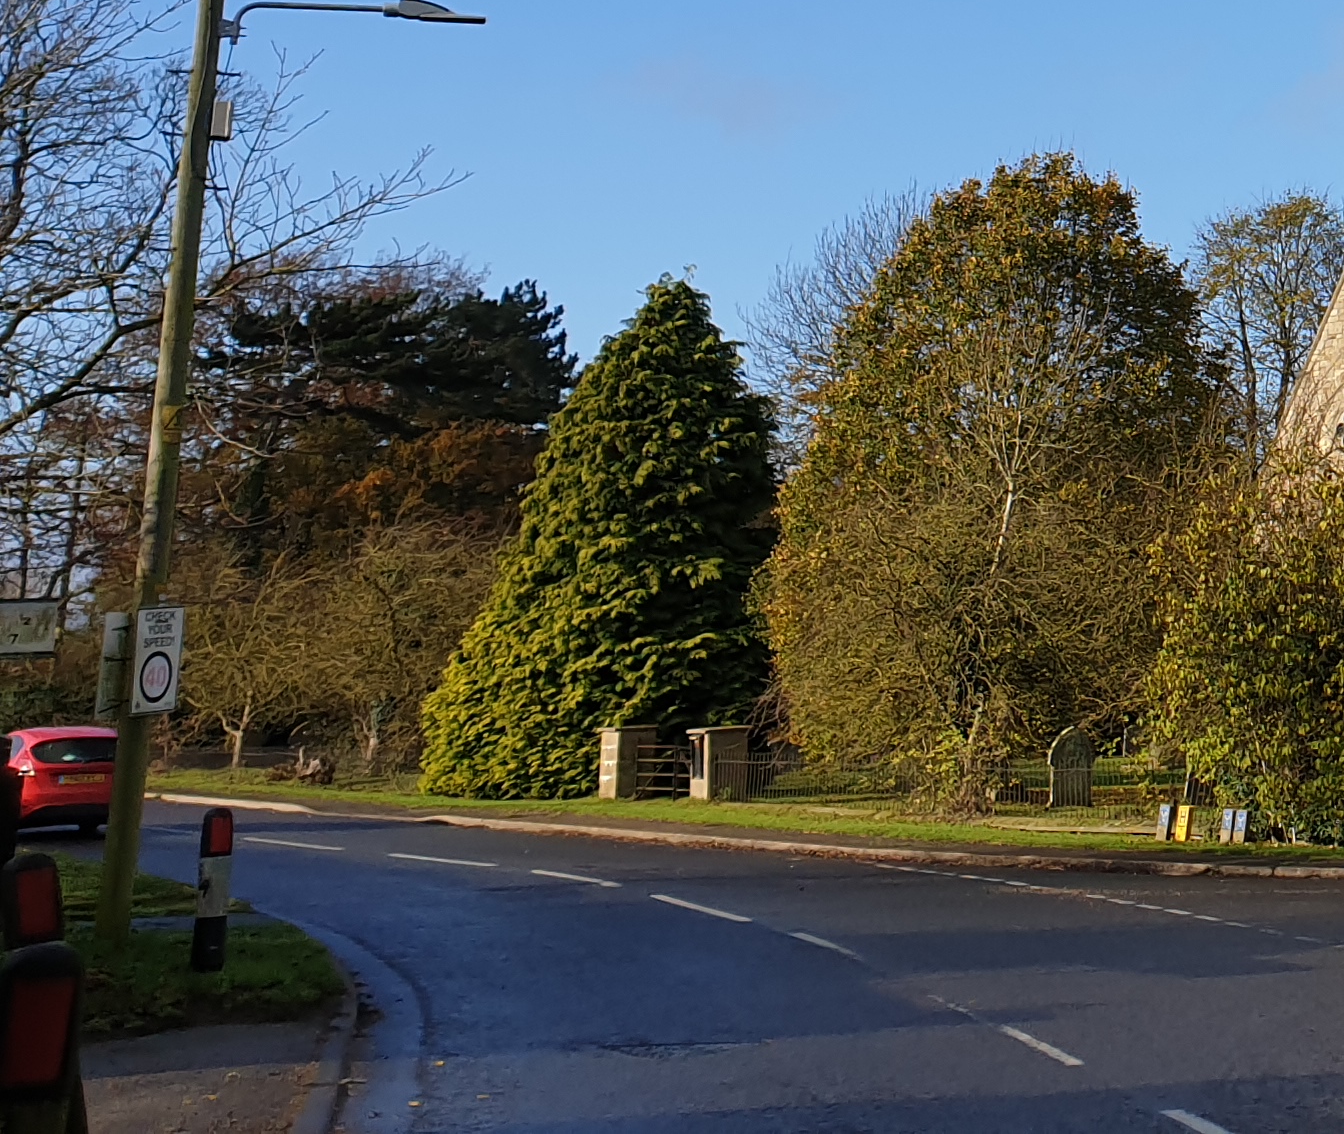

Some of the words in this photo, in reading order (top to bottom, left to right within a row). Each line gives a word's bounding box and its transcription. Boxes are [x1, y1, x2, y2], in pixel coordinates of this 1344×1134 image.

[145, 611, 176, 622] CHECK
[148, 624, 173, 635] YOUR
[145, 667, 167, 687] 40
